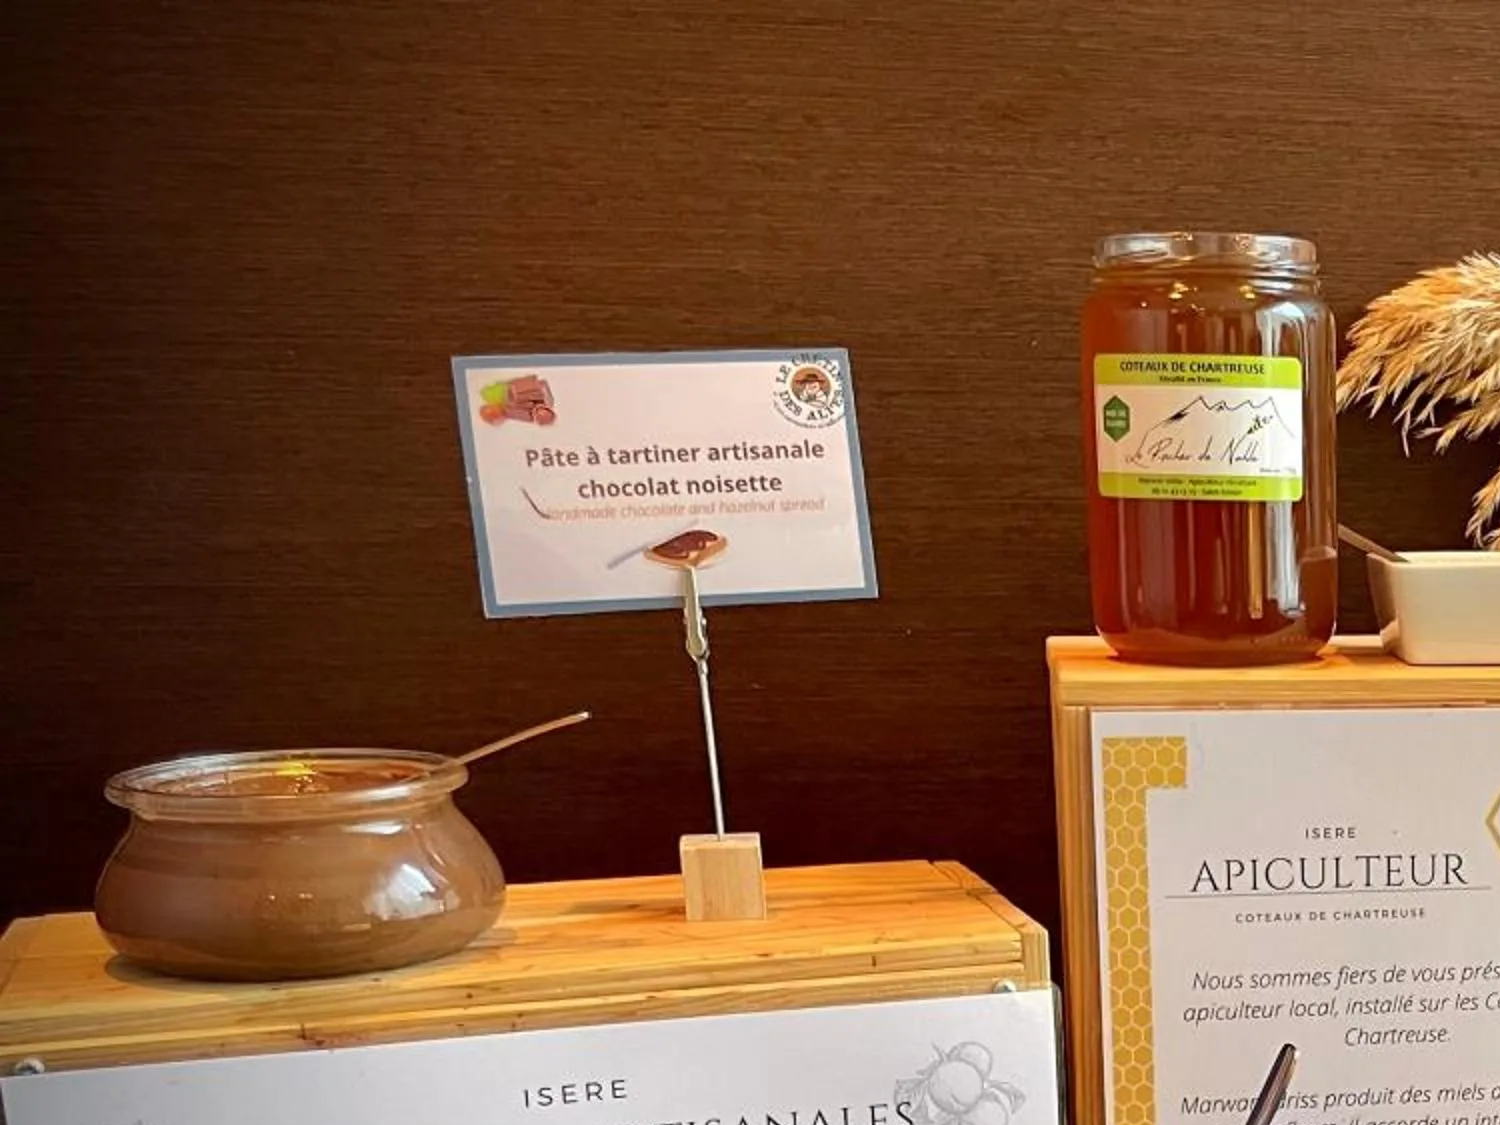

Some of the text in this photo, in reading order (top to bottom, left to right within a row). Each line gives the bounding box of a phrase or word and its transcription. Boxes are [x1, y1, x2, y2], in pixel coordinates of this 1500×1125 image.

[1119, 361, 1265, 375] COTEAUX DE CHARTREUSE
[525, 439, 825, 467] Pâte à tartiner artisanale
[578, 475, 783, 499] chocolat noisette
[689, 502, 715, 515] and
[1304, 827, 1357, 840] ISERE
[1191, 853, 1468, 892] APICULTEUR
[1235, 907, 1426, 924] COTEAUX DE CHARTREUSE
[1192, 971, 1244, 990] Nous
[1250, 969, 1332, 989] sommes
[1334, 965, 1377, 991] fiers
[1383, 964, 1406, 983] de
[1411, 967, 1456, 982] vous
[1183, 1001, 1284, 1027] apiculteur
[1289, 998, 1339, 1018] local,
[1345, 994, 1413, 1015] installé
[1418, 998, 1449, 1013] sur
[1455, 994, 1479, 1011] les
[1344, 1026, 1450, 1046] Chartreuse.
[523, 1079, 628, 1108] ISERE
[1323, 1087, 1394, 1112] produit
[1400, 1084, 1432, 1104] des
[1437, 1083, 1485, 1101] miels
